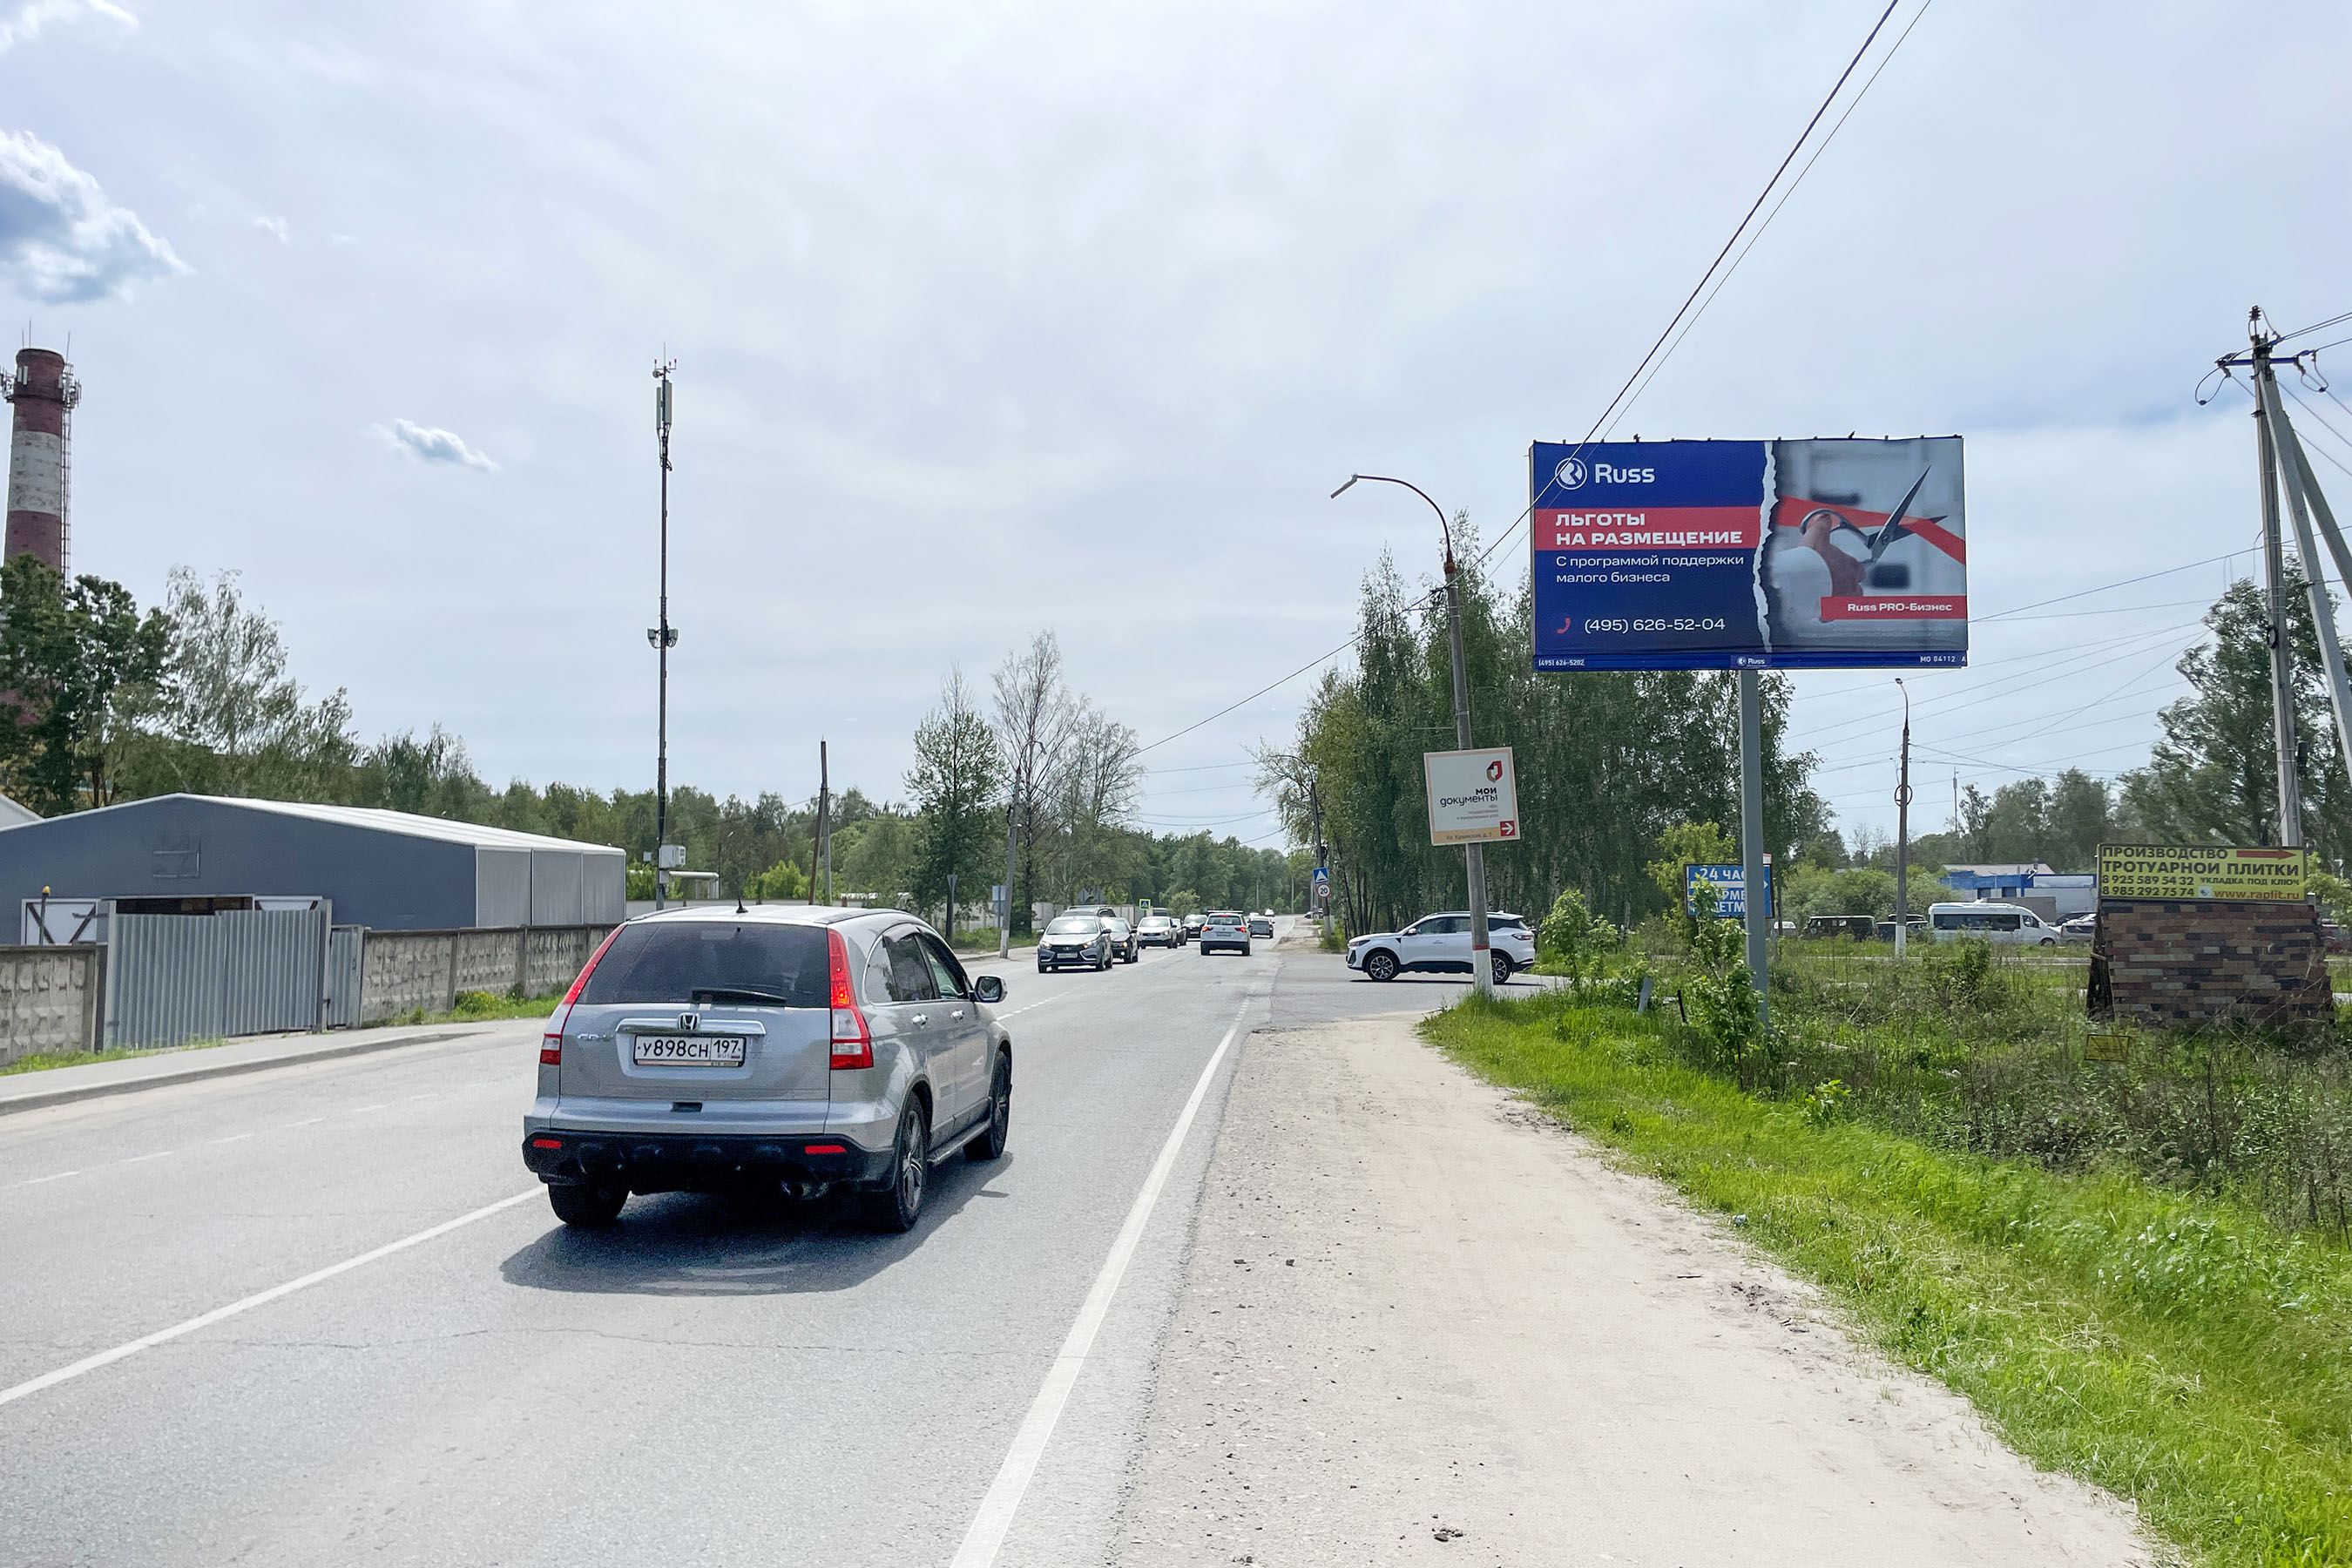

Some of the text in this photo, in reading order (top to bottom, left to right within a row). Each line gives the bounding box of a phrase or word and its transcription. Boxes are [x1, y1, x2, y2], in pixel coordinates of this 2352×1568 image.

[1595, 463, 1655, 483] Russ
[1556, 513, 1646, 526] ЛЬГОТЫ
[1556, 531, 1743, 546] НА РАЗМЕЩЕНИЕ
[1556, 555, 1745, 569] С программой поддержки
[1556, 571, 1671, 583] малого бизнеса
[1848, 602, 1953, 612] Russ PRO-Бизнес
[1584, 618, 1727, 634] (495) 626-52-04
[1475, 787, 1497, 795] мои
[1440, 794, 1498, 808] документы
[2103, 847, 2228, 861] ПРОИЗВОДСТВО
[1700, 868, 1720, 881] 24
[2227, 862, 2299, 876] ПЛИТКИ
[2112, 875, 2134, 884] 925
[2136, 875, 2159, 884] 589
[2161, 875, 2177, 885] 54
[2179, 876, 2194, 885] 32
[2102, 886, 2194, 896] 8 985 292 75 74
[2213, 889, 2300, 900] www.raplit.ru
[643, 1039, 739, 1058] У898СН 197
